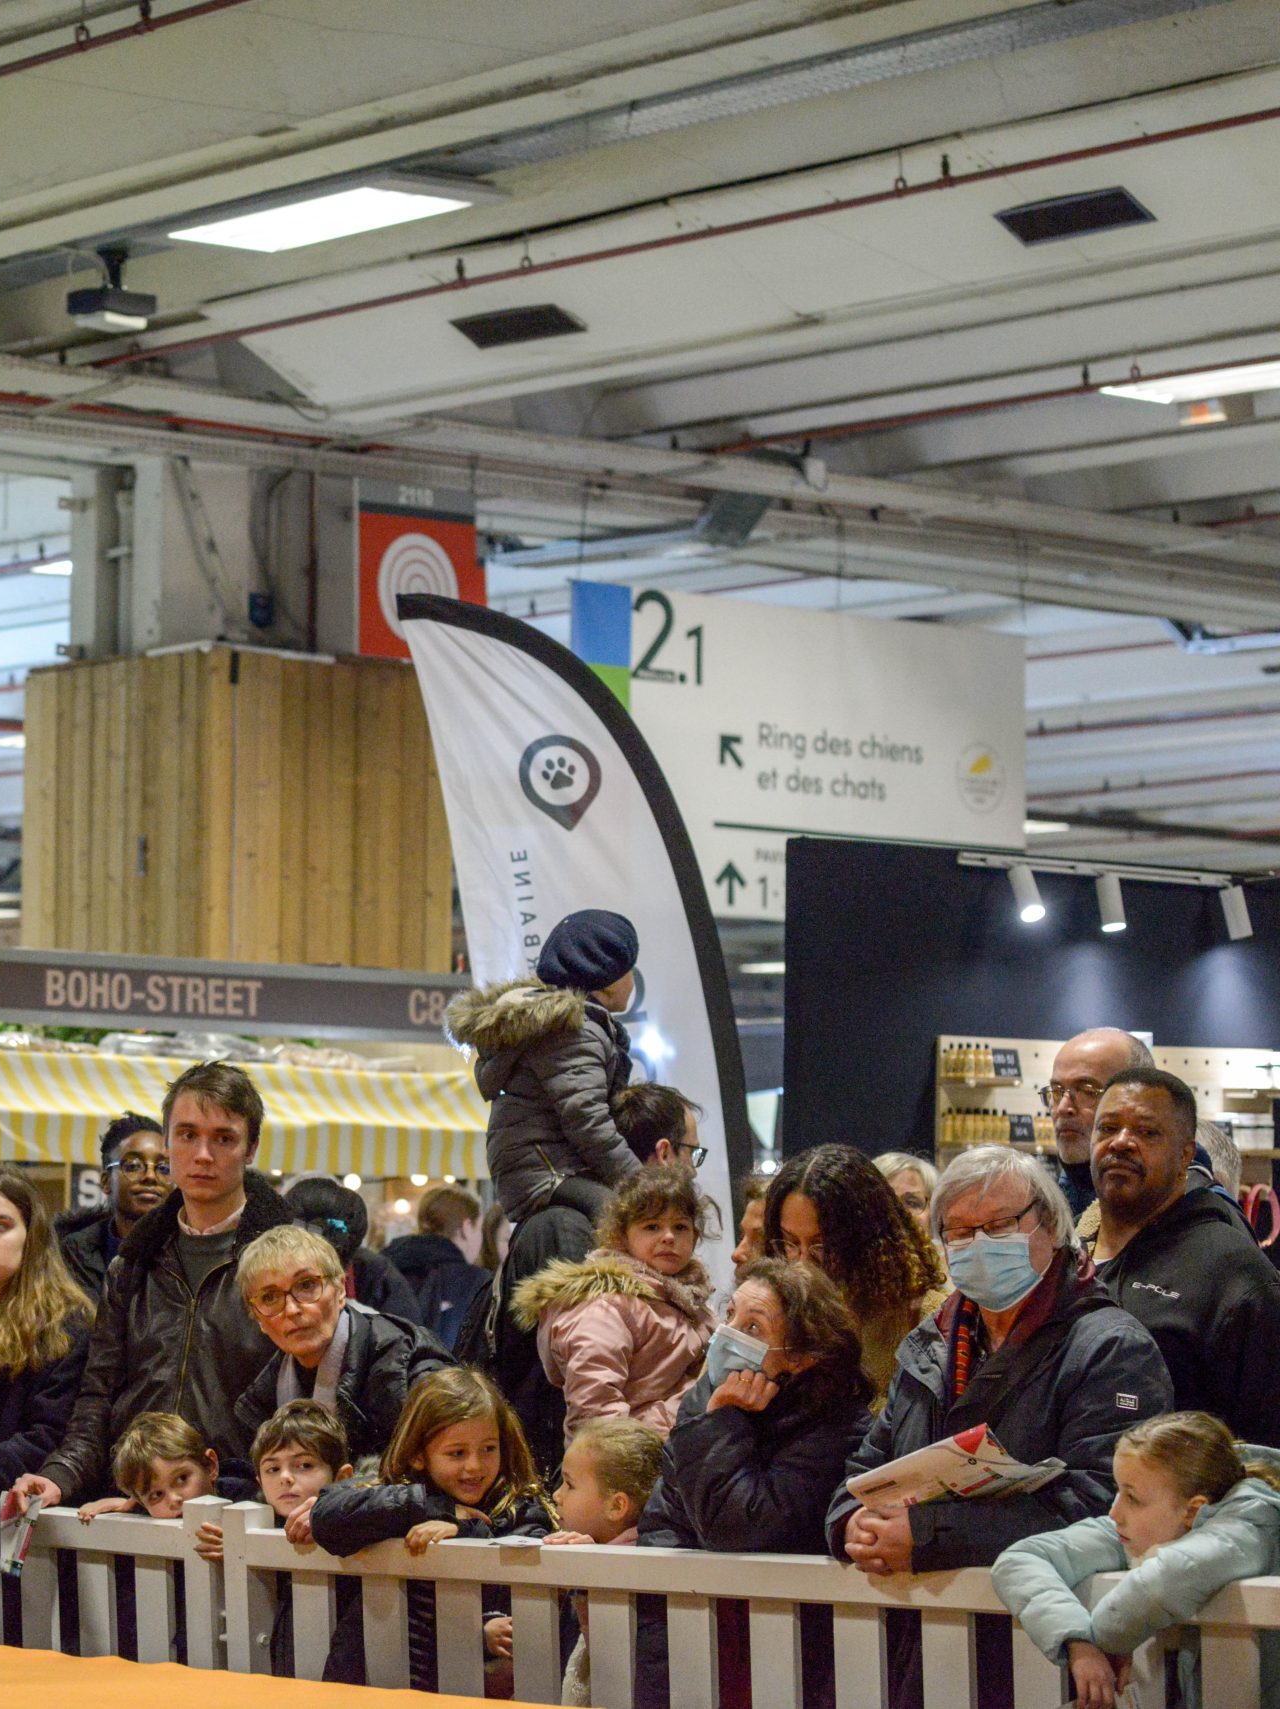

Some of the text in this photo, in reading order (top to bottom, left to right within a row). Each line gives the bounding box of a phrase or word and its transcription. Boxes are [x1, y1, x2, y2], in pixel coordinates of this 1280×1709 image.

[632, 588, 704, 686] 2.1
[758, 722, 924, 765] Ring des chiens
[757, 767, 886, 801] et des chats
[45, 968, 263, 1017] BOHO-STREET
